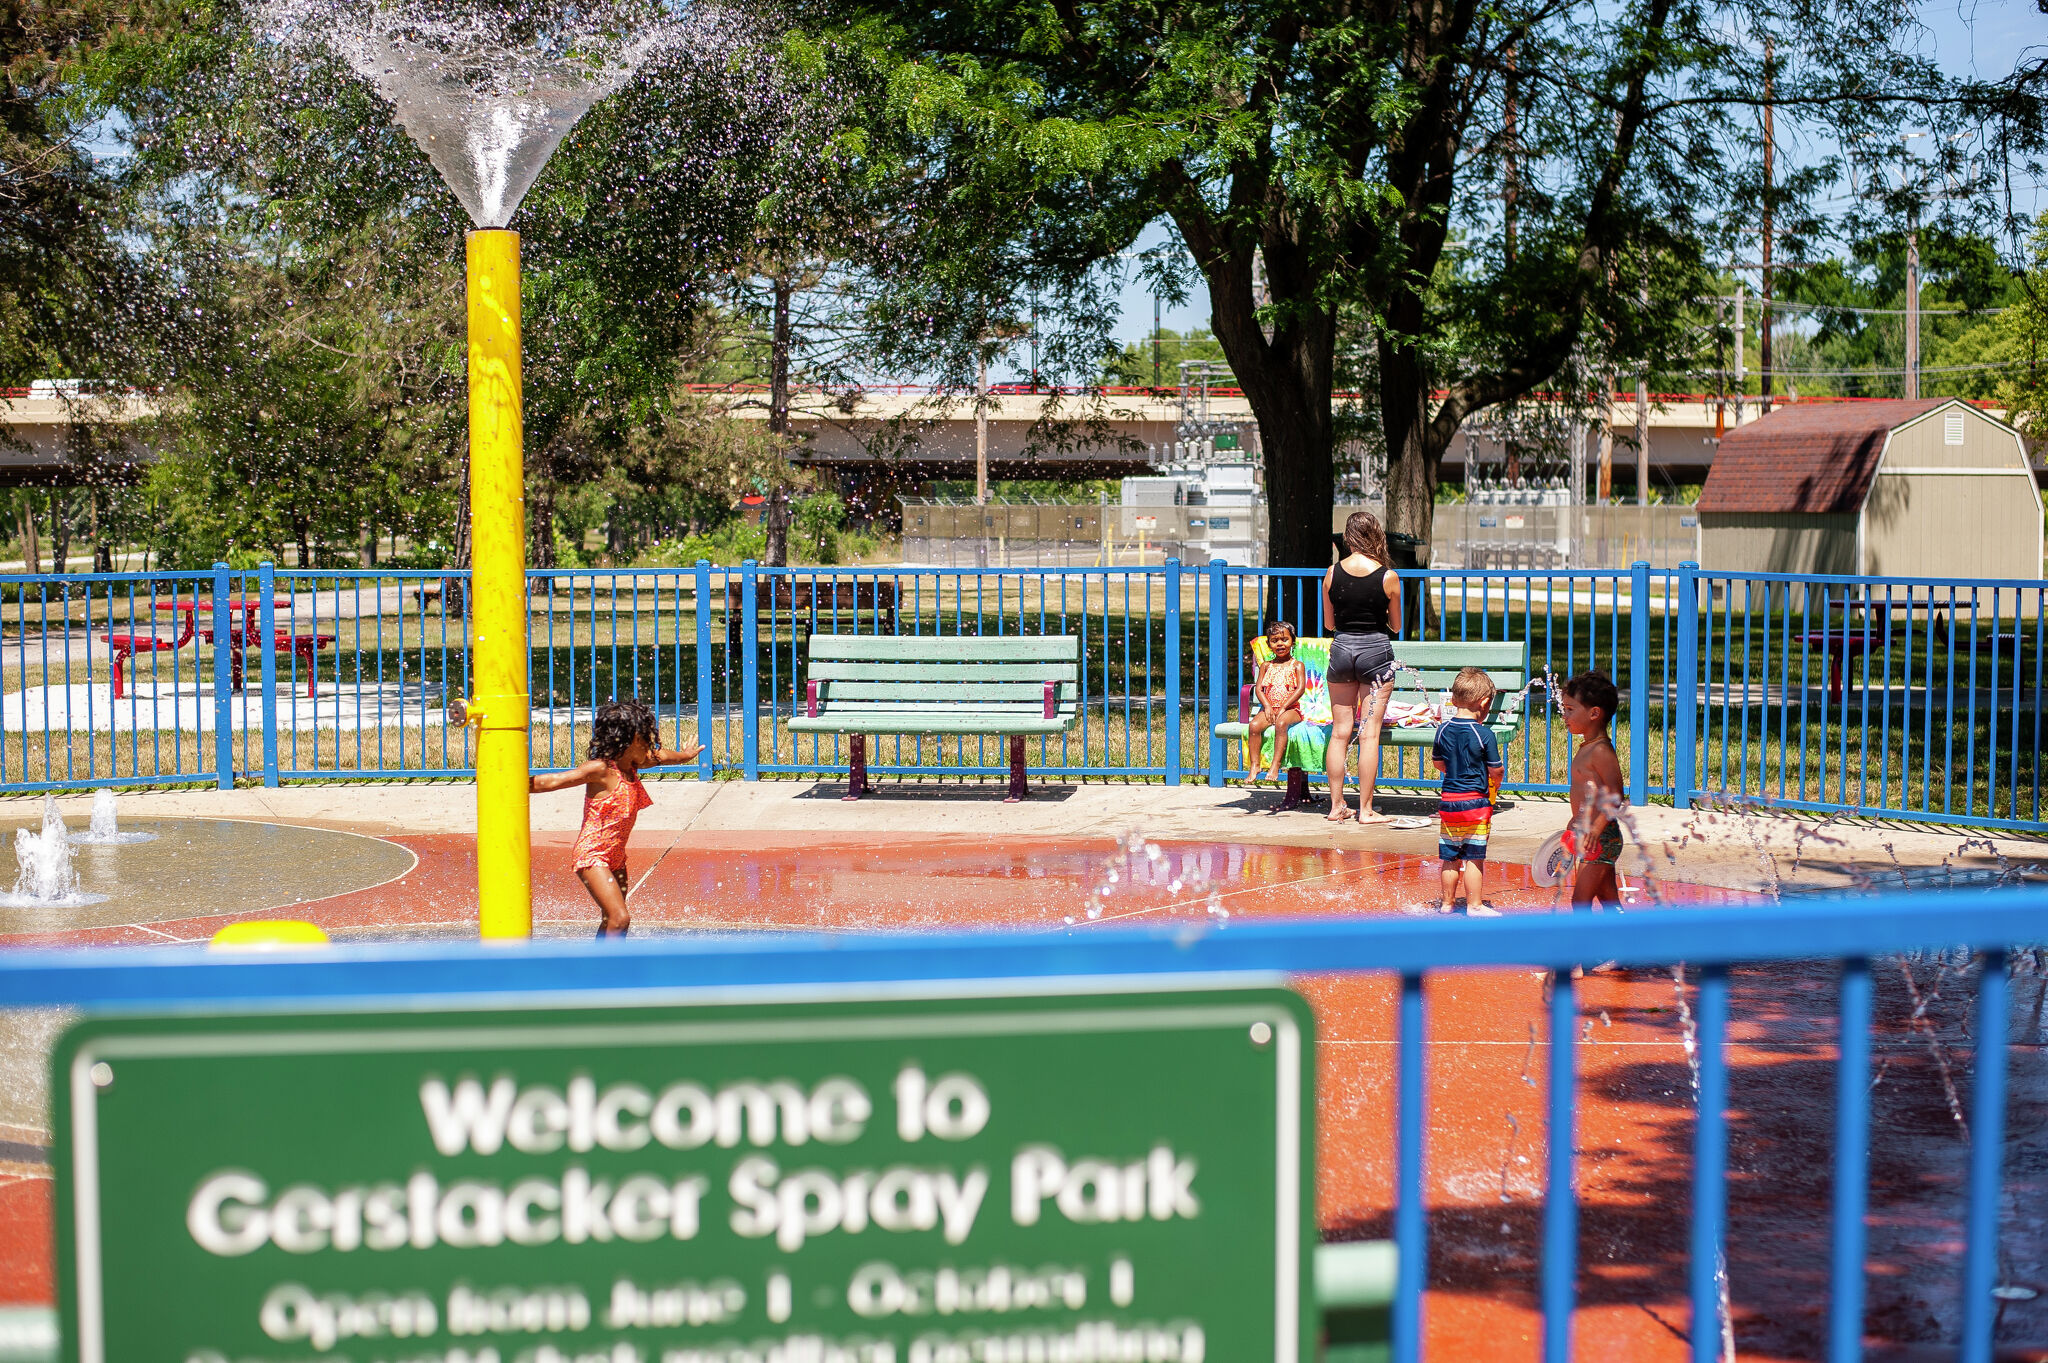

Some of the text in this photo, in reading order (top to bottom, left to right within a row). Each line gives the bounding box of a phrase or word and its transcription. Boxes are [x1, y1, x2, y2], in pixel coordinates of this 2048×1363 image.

[420, 1064, 990, 1156] Welcome to
[187, 1143, 1199, 1256] Gerstacker Spray Park
[259, 1283, 439, 1351] Open
[447, 1279, 591, 1335] from
[603, 1276, 746, 1329] June
[766, 1270, 792, 1323] 1
[847, 1260, 1087, 1316] October
[1109, 1257, 1135, 1307] 1
